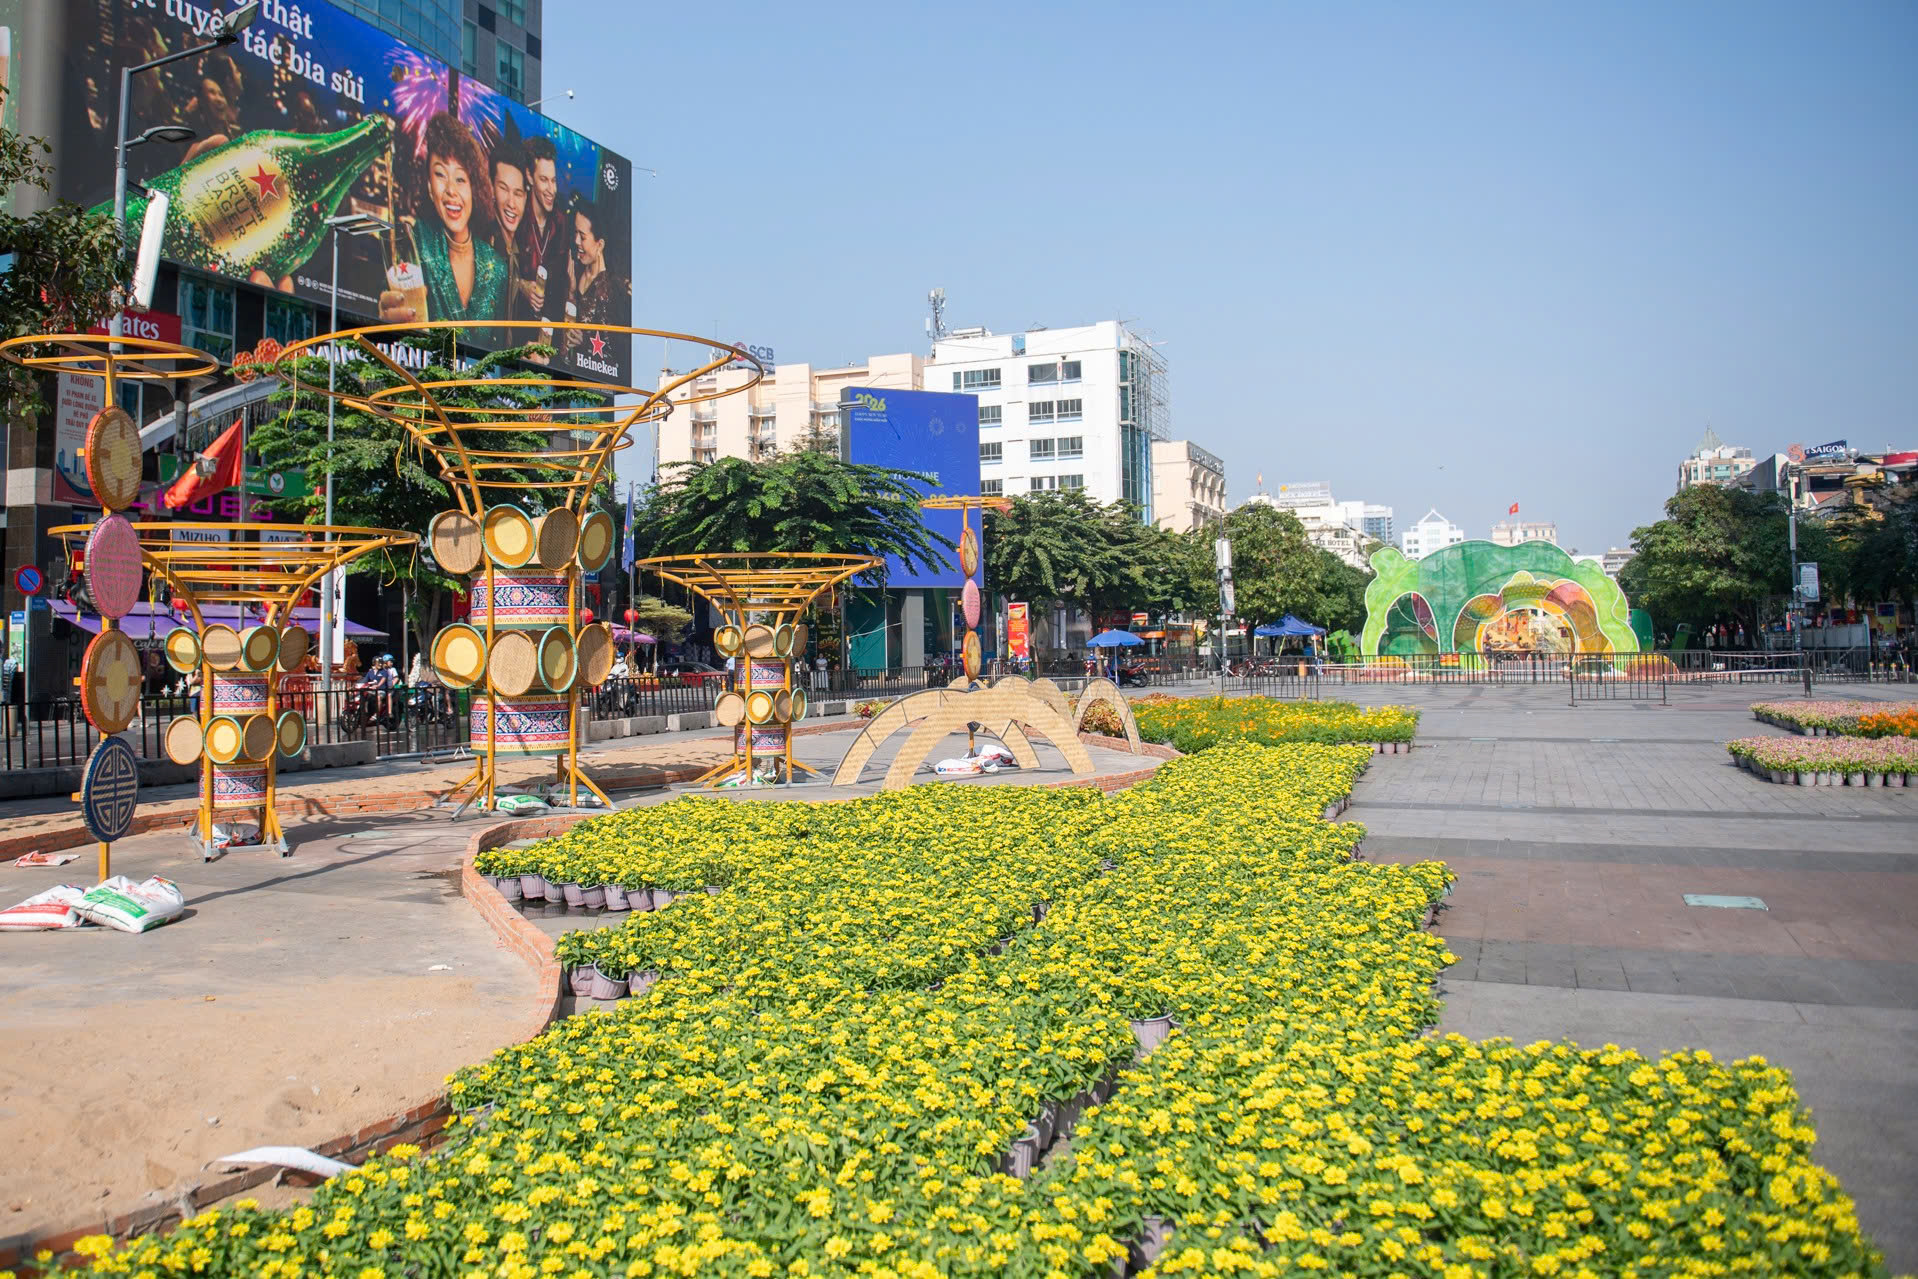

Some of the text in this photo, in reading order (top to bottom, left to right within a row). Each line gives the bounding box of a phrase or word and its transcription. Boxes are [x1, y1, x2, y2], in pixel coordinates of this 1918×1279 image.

[262, 0, 313, 41] thật
[165, 0, 365, 104] tuyệ tác bia sủi
[205, 177, 247, 239] LAGER
[215, 171, 258, 228] BRUT
[576, 352, 619, 377] Heineken
[855, 393, 888, 412] 2026
[1811, 444, 1846, 454] SAIGON
[178, 530, 221, 543] MIZUHO
